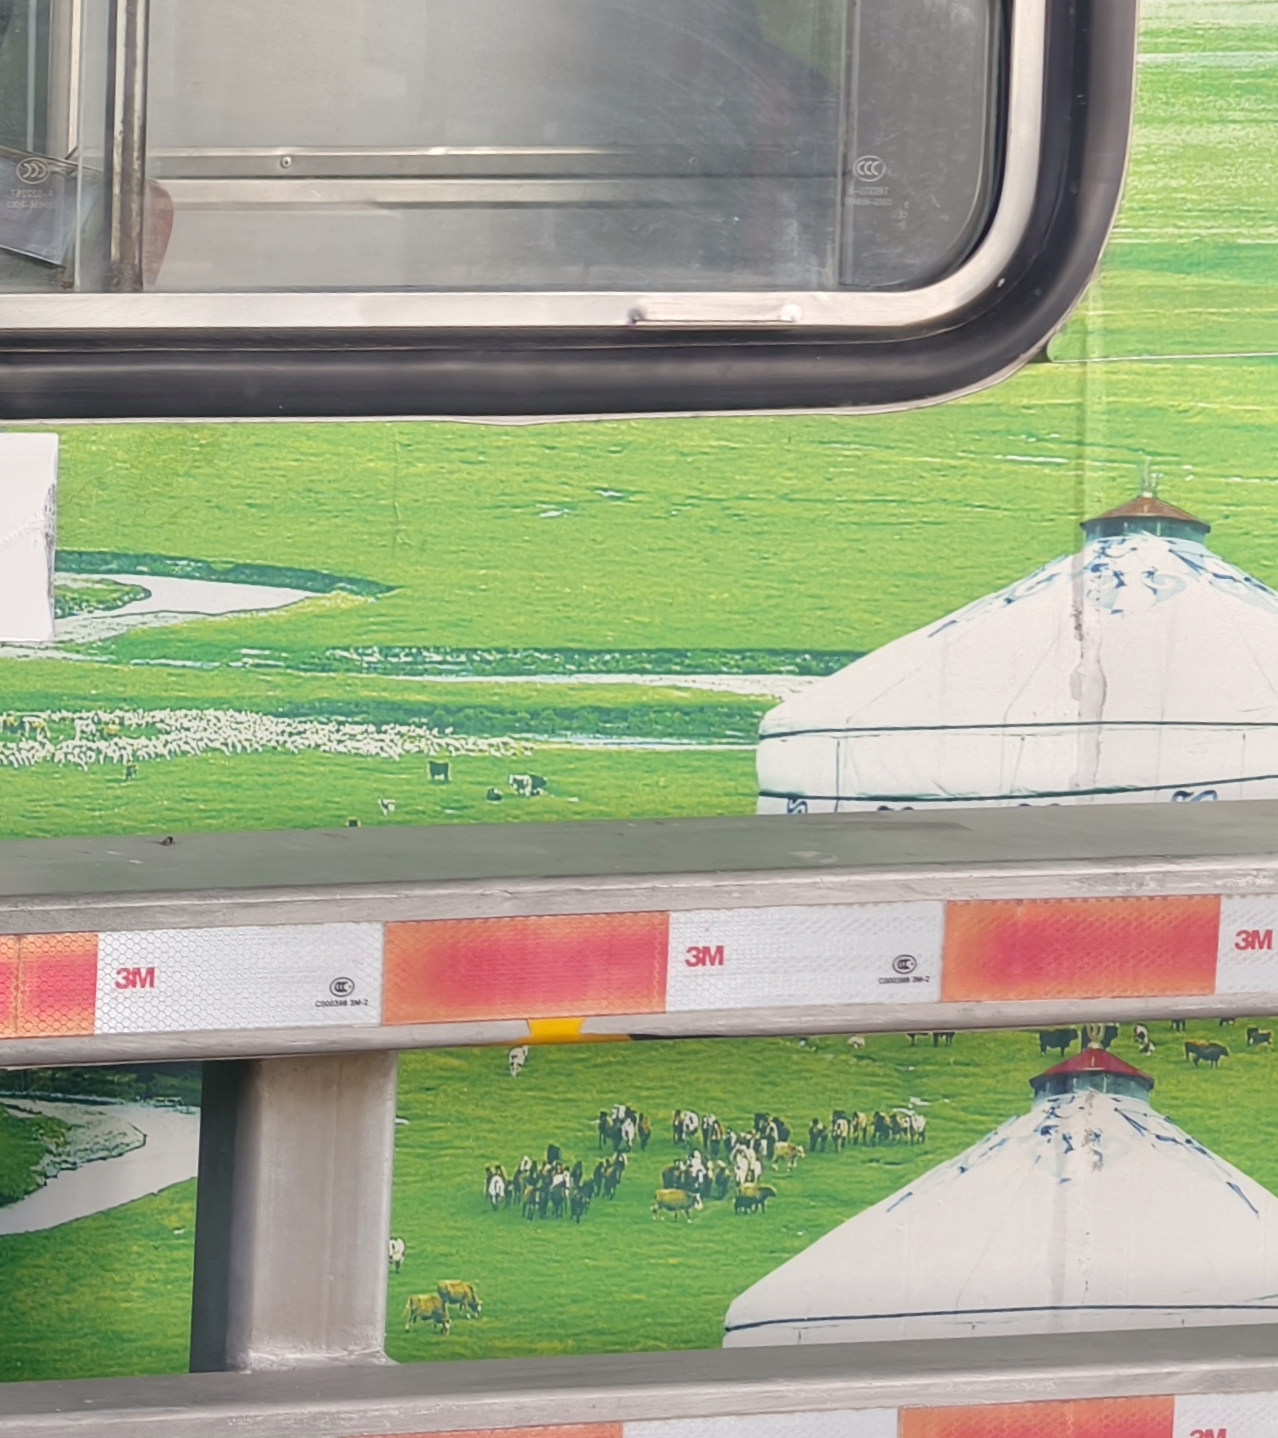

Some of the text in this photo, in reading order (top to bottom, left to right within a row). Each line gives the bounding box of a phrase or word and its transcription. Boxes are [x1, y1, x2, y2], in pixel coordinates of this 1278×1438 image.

[1234, 930, 1273, 952] 3M
[686, 946, 725, 968] 3M
[116, 968, 156, 990] 3M
